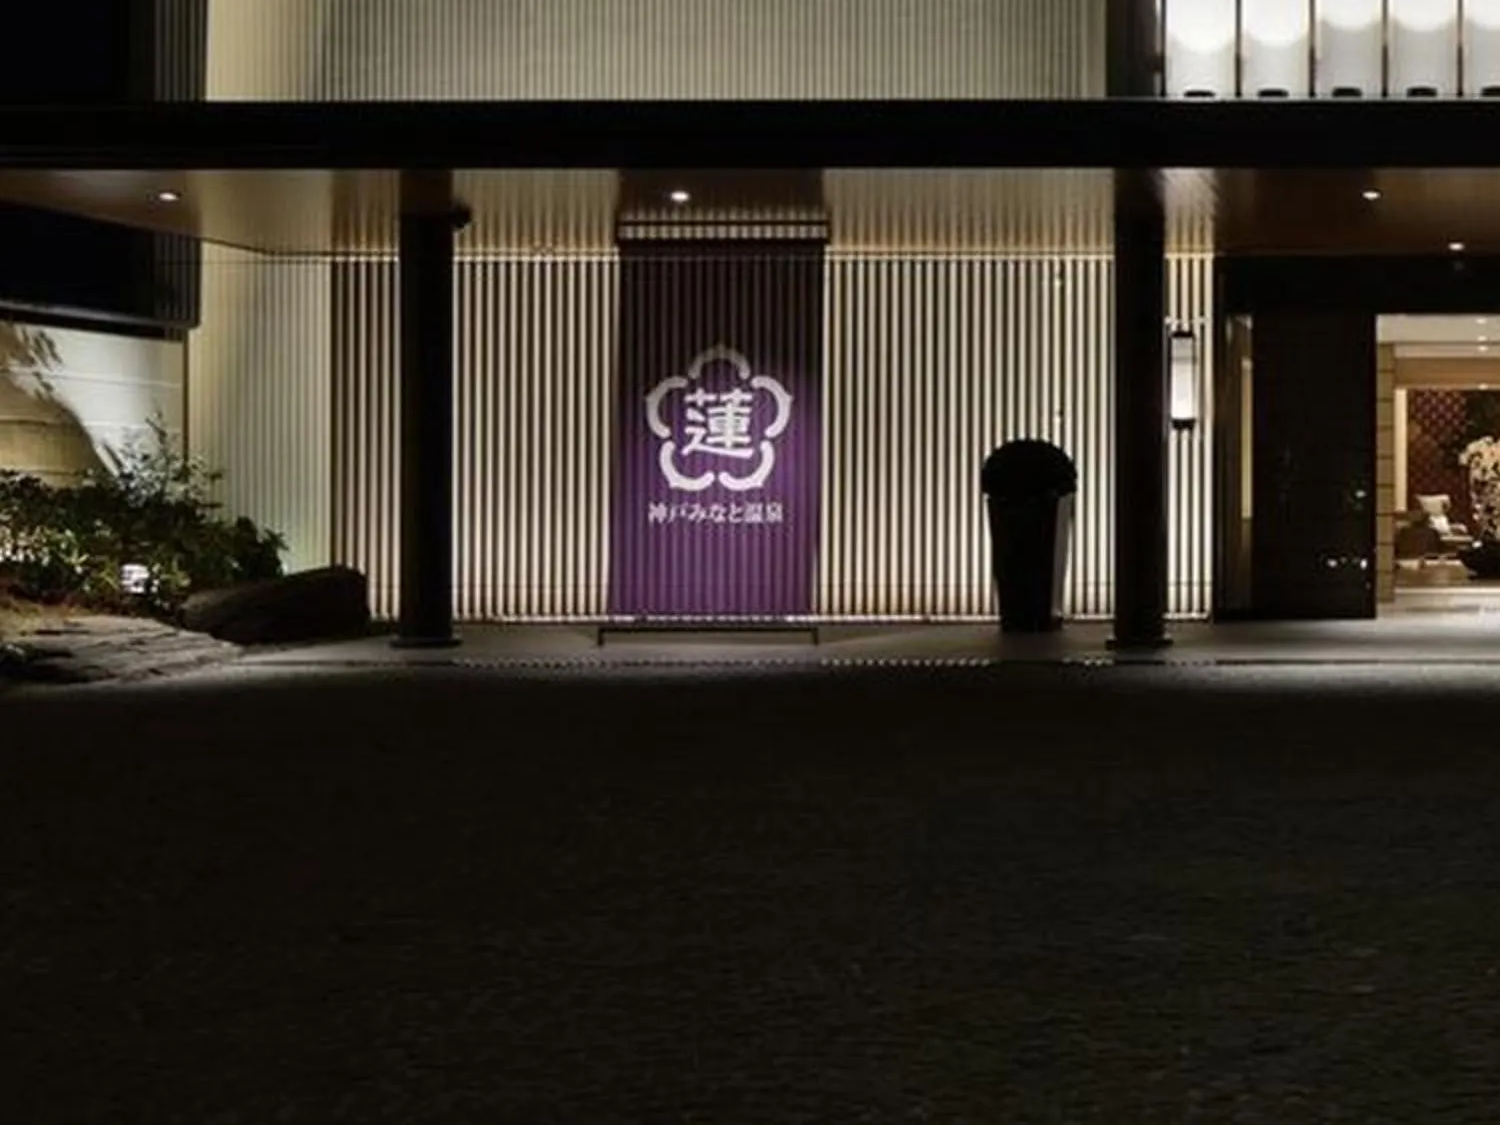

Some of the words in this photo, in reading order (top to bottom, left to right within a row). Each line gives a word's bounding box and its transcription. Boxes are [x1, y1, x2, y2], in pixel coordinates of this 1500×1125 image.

[682, 388, 753, 459] 蓮
[648, 501, 784, 524] 神戸みなと温泉
